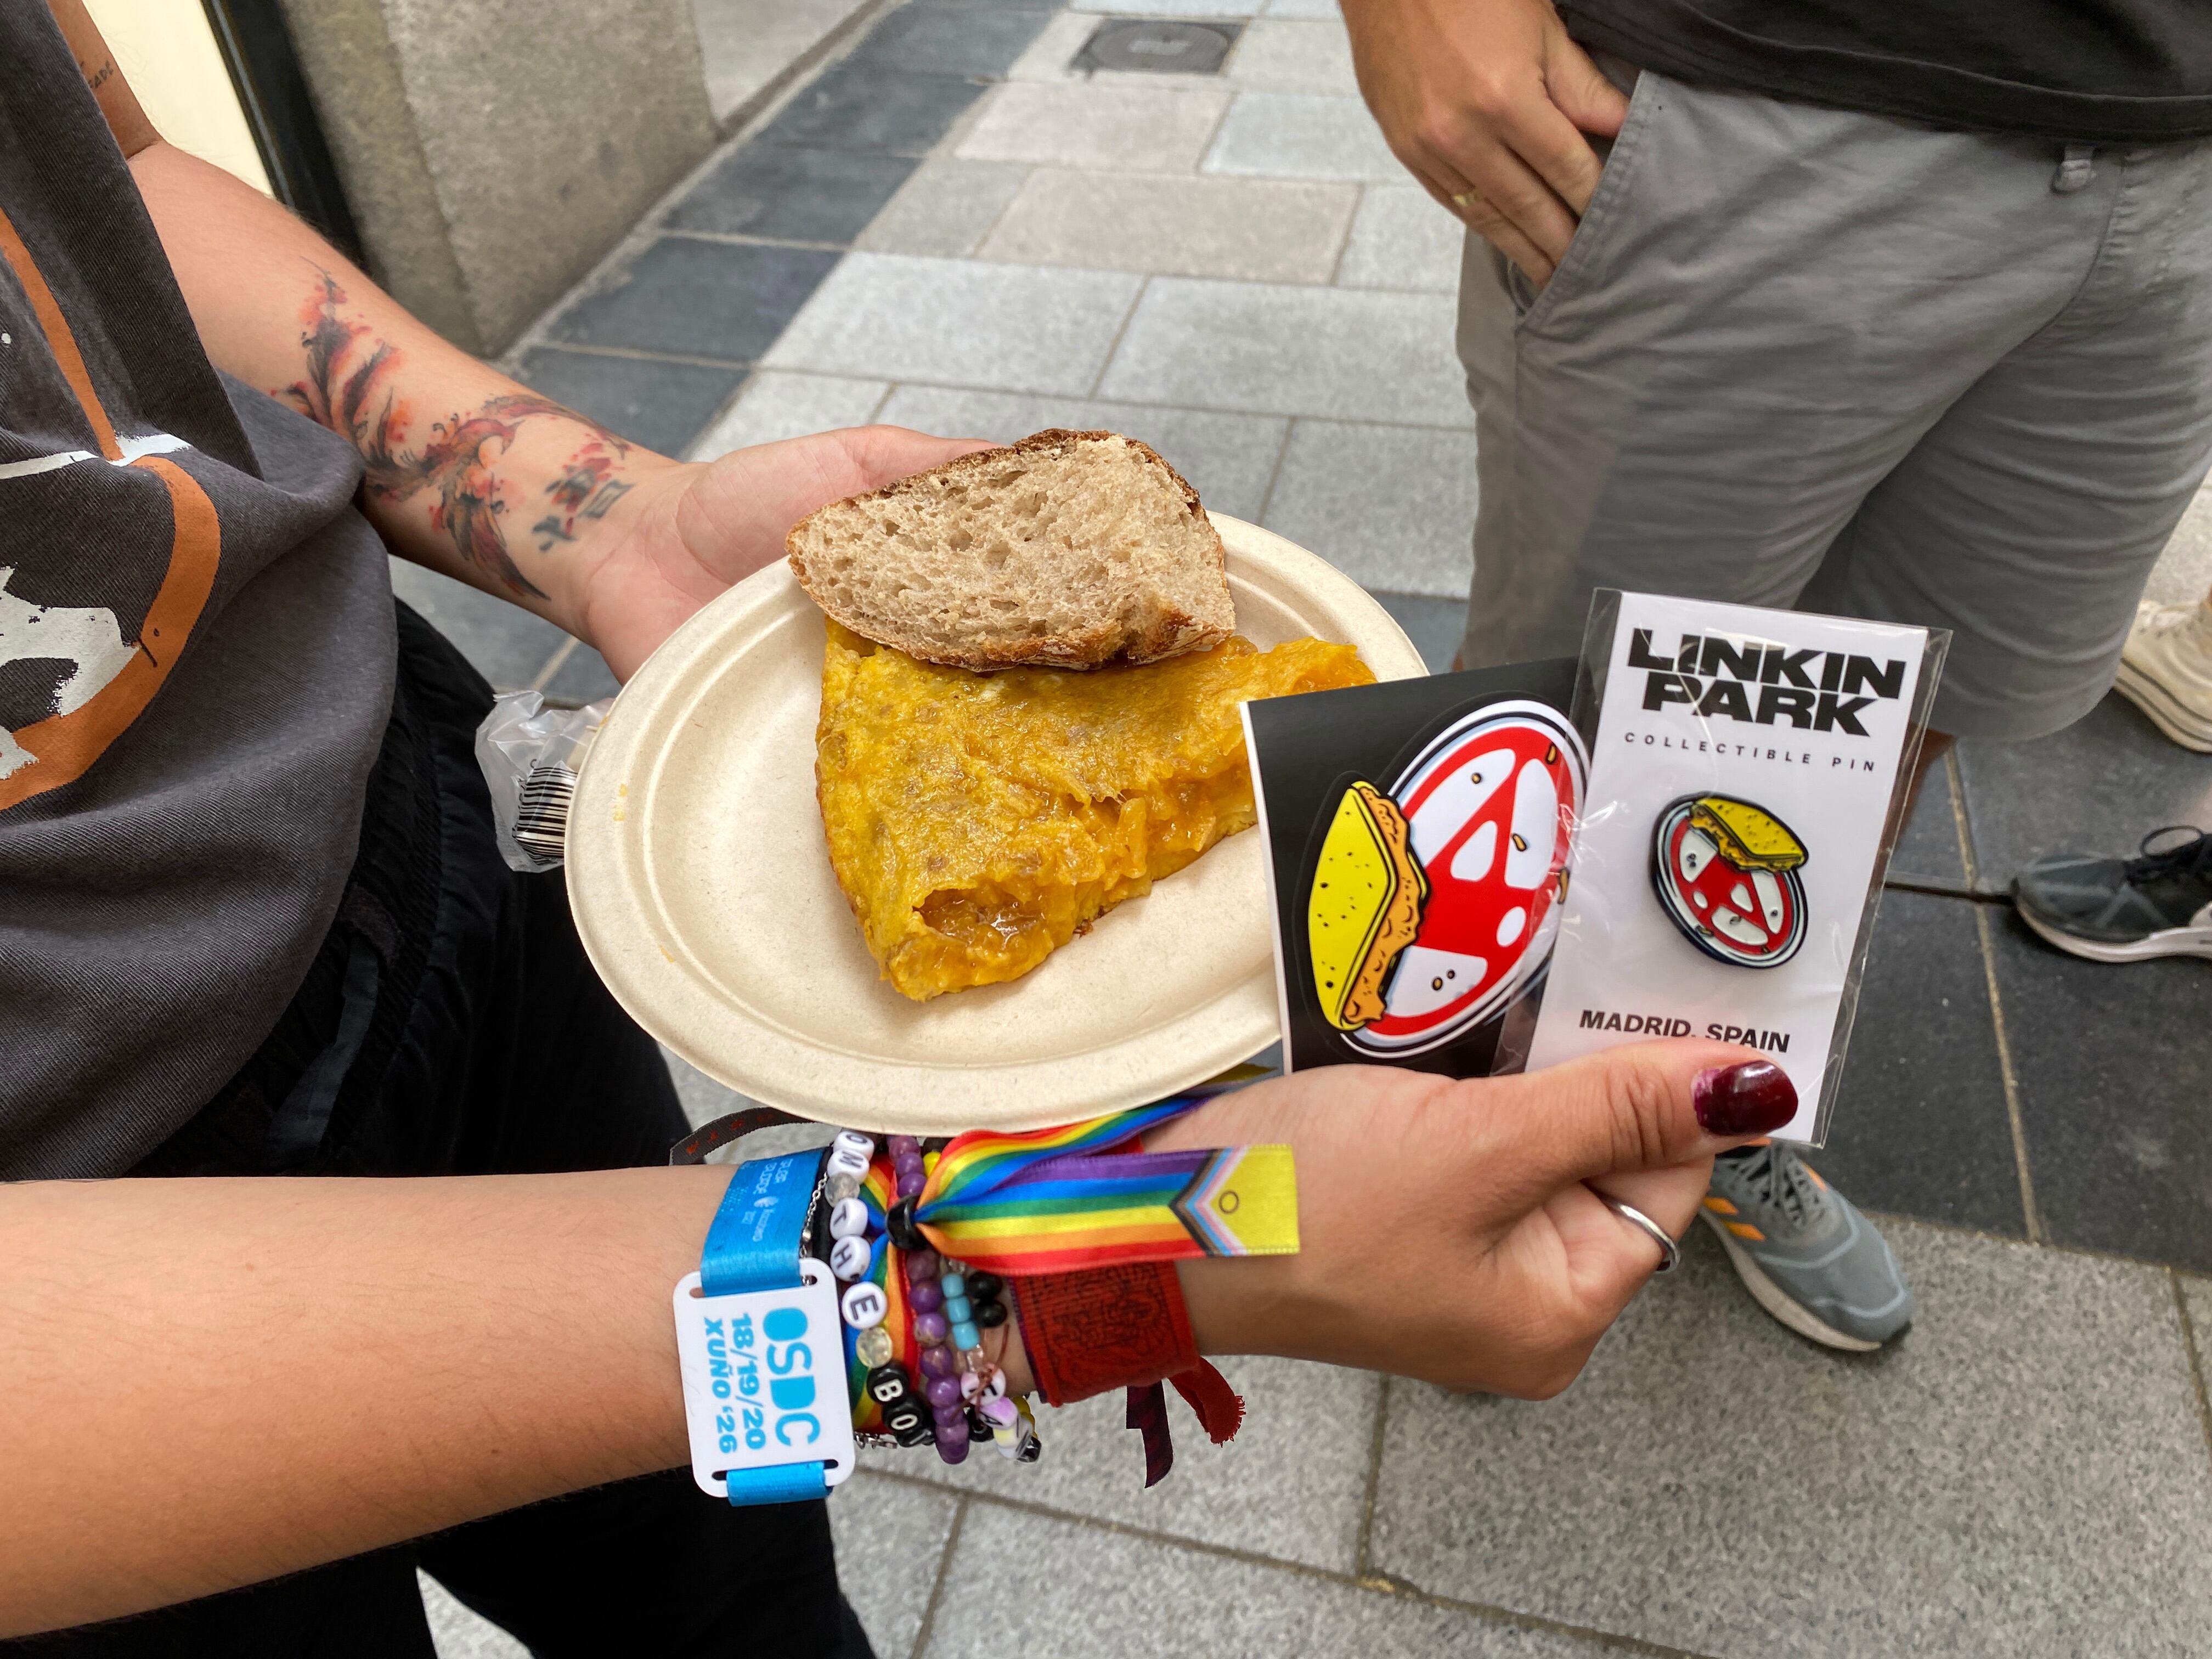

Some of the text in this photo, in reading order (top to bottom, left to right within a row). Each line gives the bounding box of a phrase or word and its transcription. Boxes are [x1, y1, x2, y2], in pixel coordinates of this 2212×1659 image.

[1628, 628, 1906, 699] LINKIN
[1641, 670, 1878, 738] PARK
[1624, 731, 1875, 772] COLLECTIBLE PIN
[1705, 1023, 1790, 1053] SPAIN
[833, 1205, 878, 1321] THE
[703, 1317, 733, 1398] XUÑO
[730, 1312, 766, 1450] 18/19/20
[763, 1307, 821, 1446] OSDC
